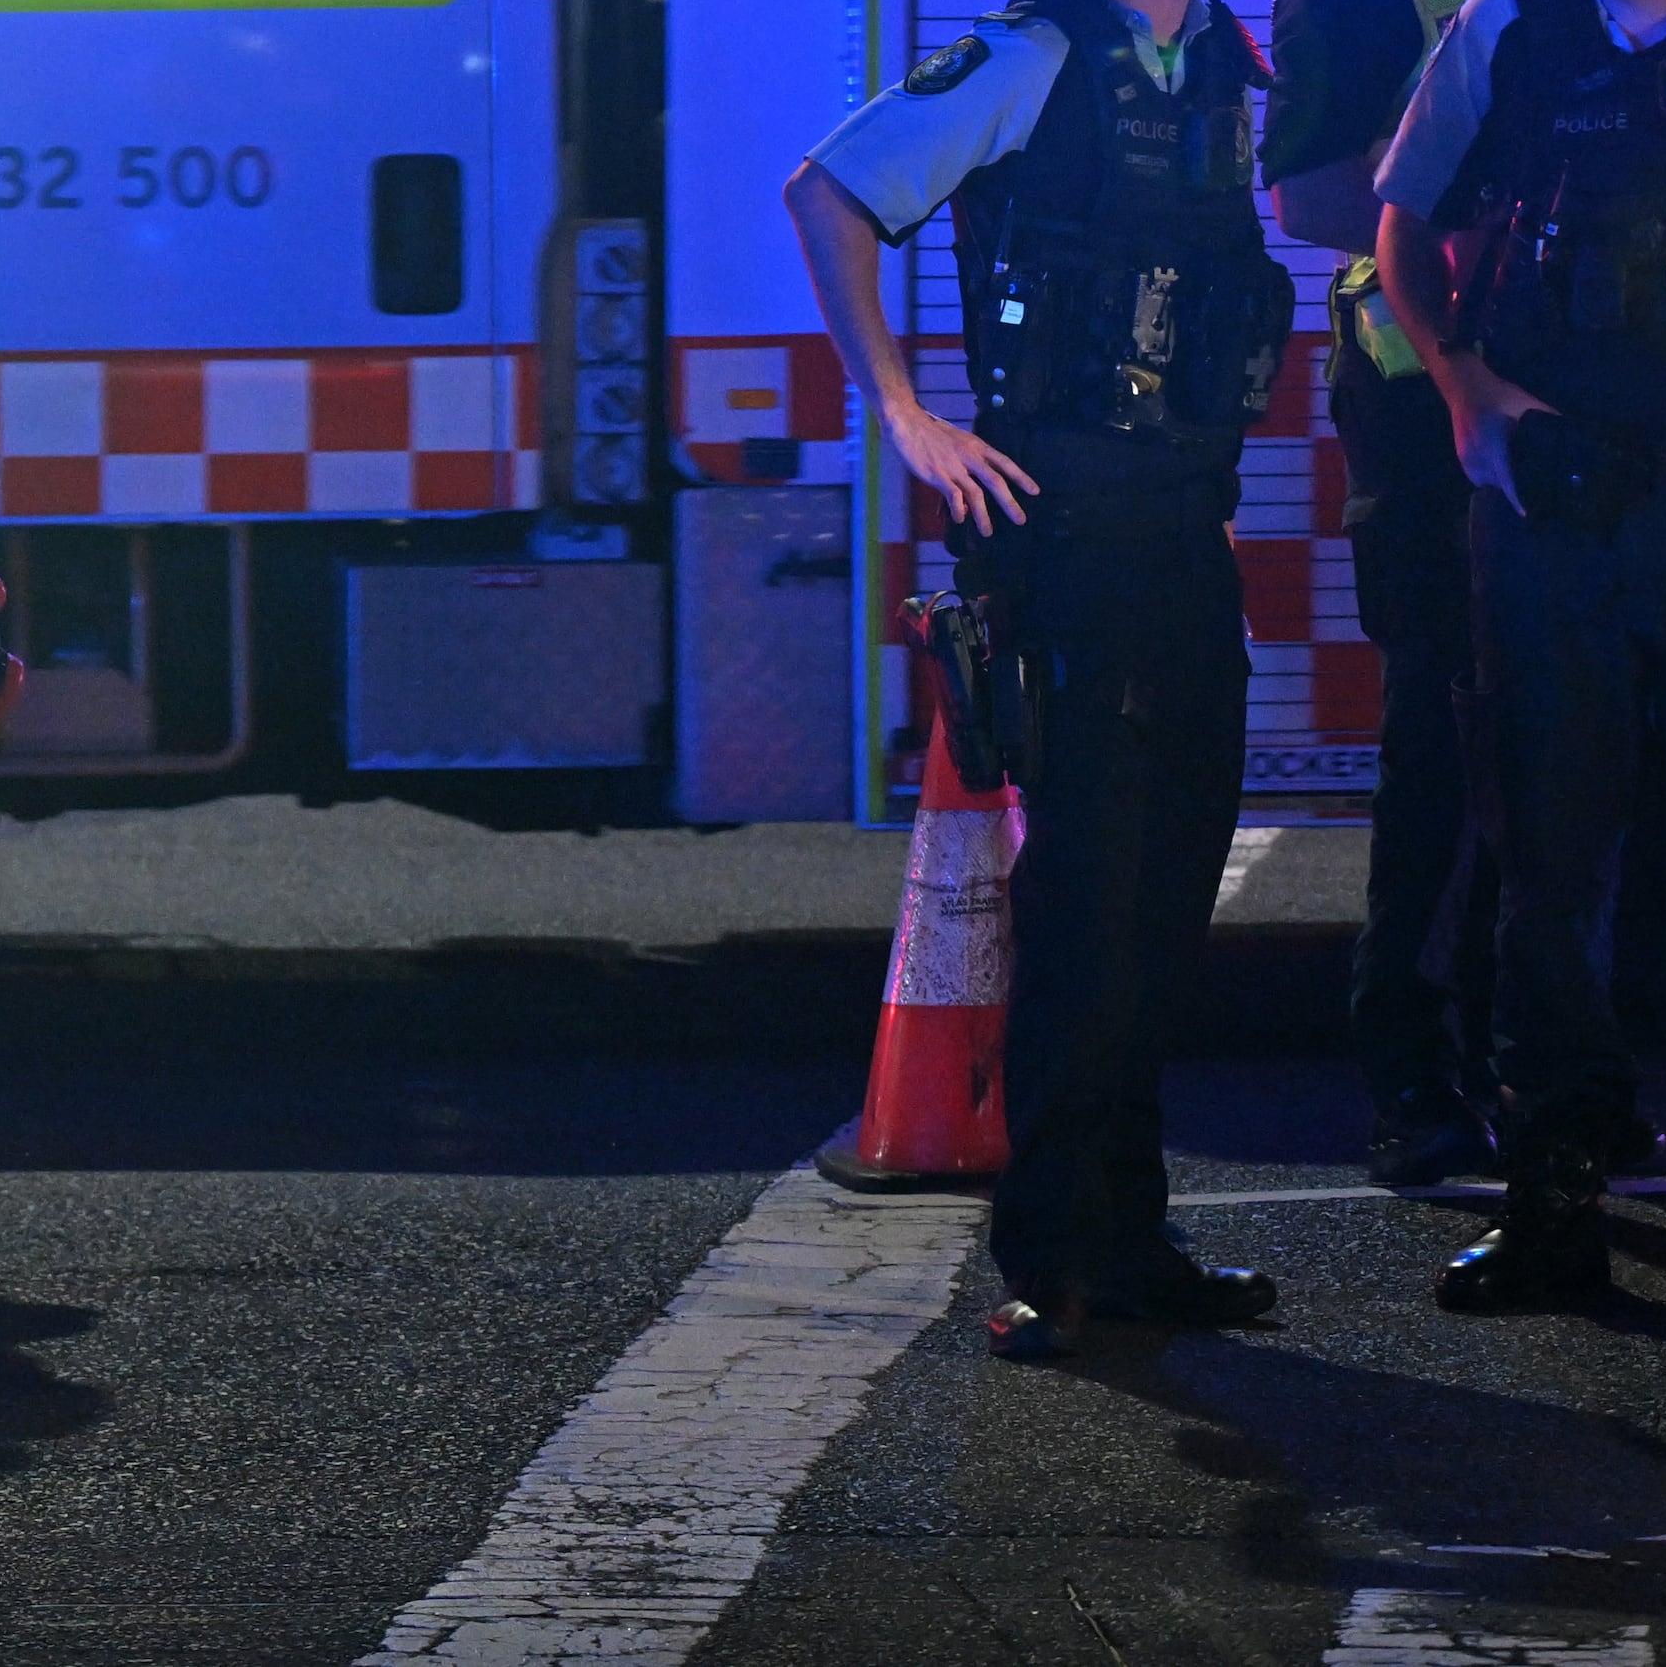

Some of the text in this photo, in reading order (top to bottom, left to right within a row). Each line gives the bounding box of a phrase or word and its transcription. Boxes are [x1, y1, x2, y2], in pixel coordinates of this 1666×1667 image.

[1116, 117, 1180, 143] POLICE
[1552, 112, 1629, 134] POLICE
[116, 146, 274, 209] 500
[1250, 750, 1379, 778] OCKER
